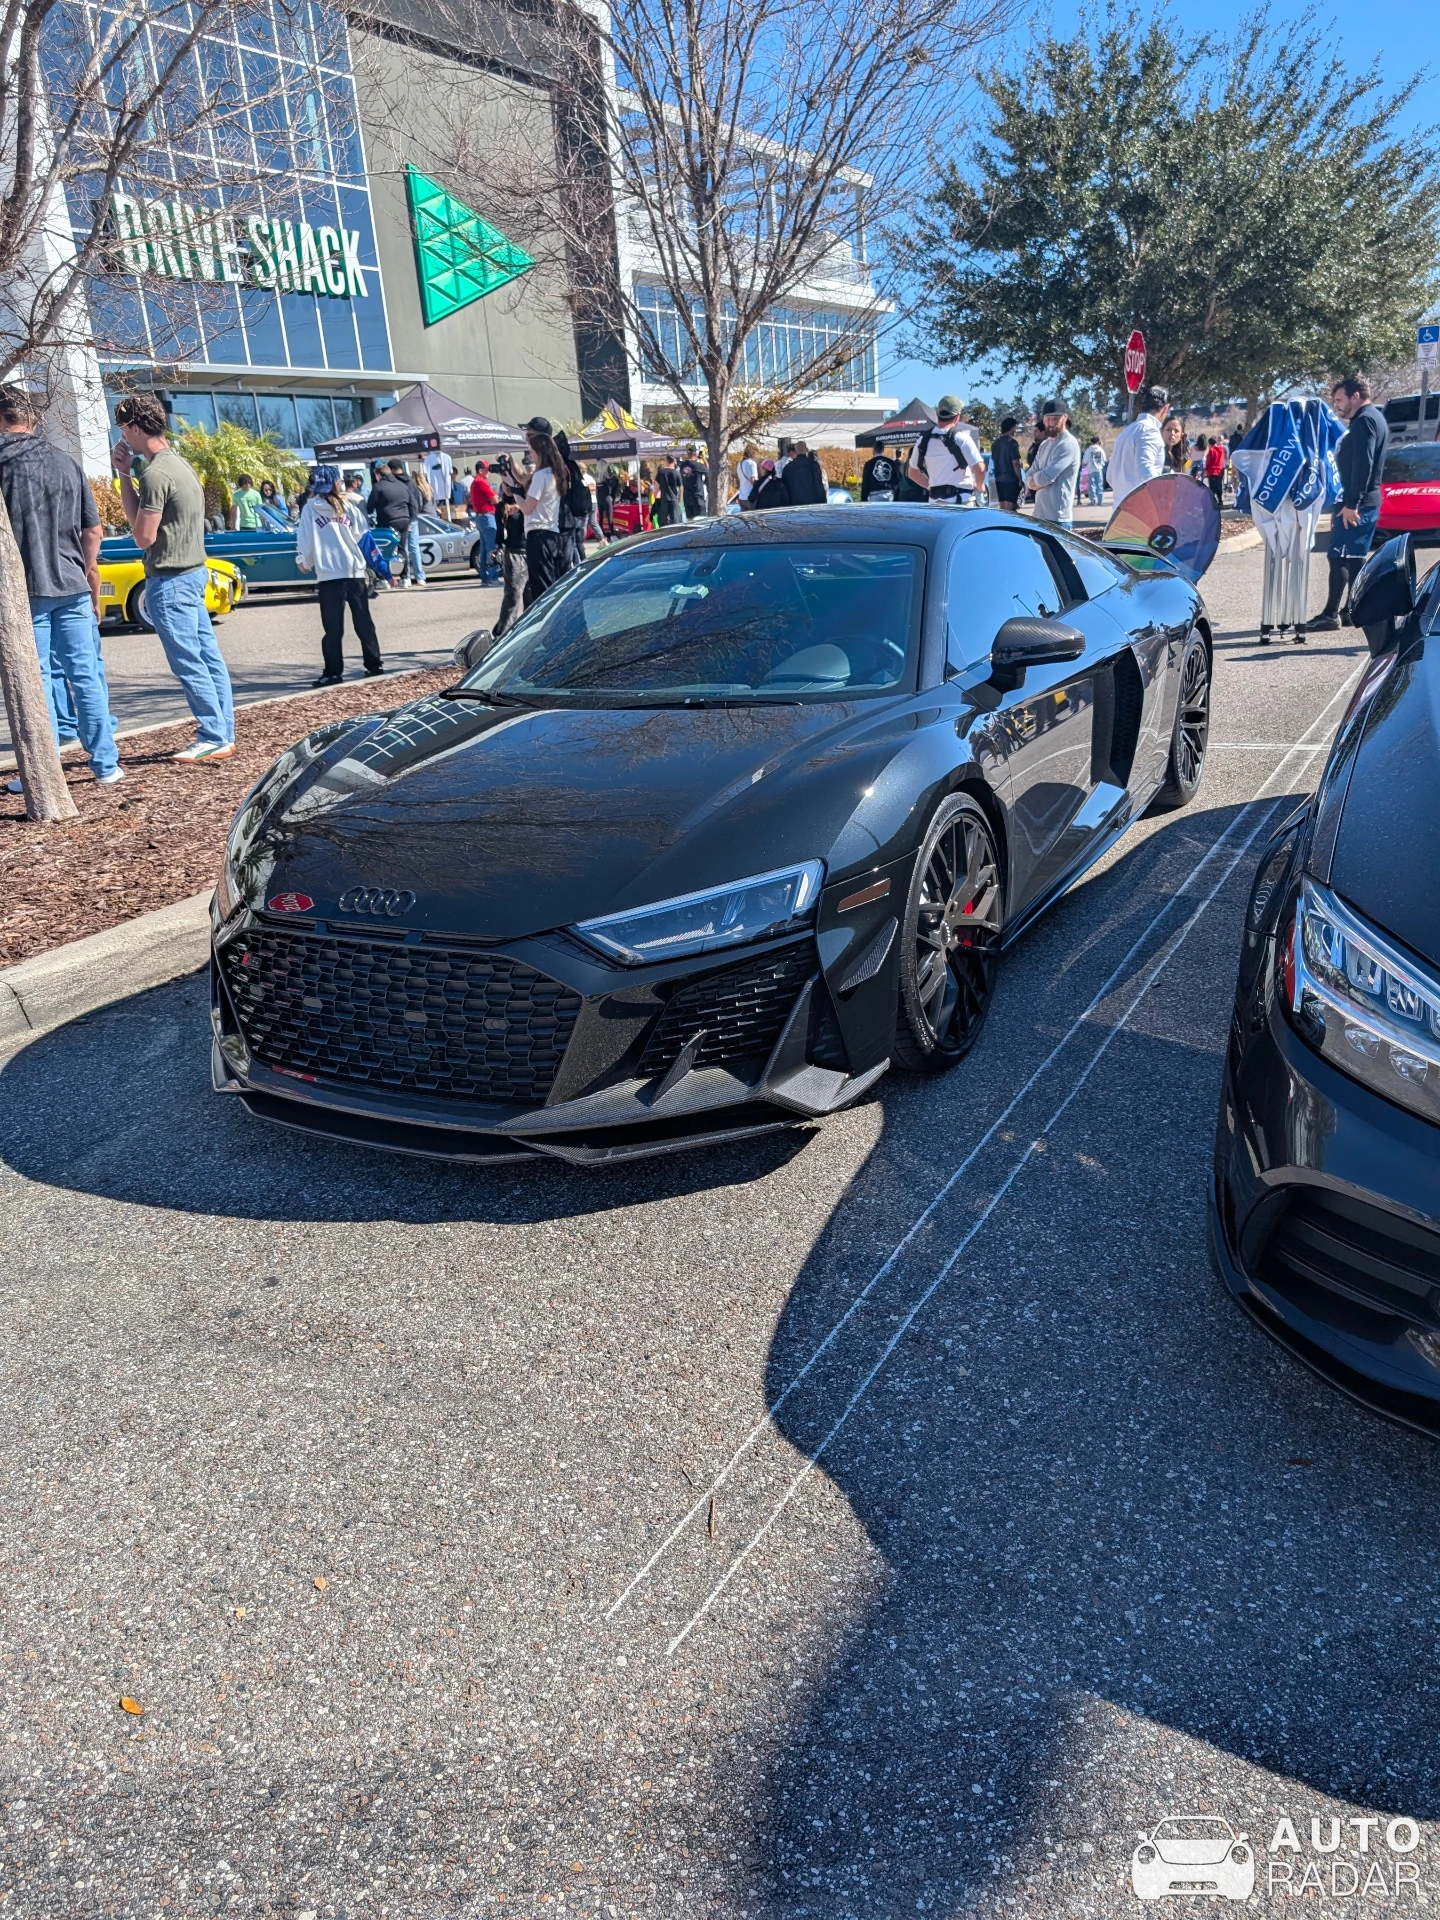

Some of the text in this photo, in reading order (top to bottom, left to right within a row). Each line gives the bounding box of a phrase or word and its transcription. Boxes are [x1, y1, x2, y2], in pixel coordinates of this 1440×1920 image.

[112, 192, 369, 298] DRIVE SHACK
[1125, 349, 1145, 375] STOP
[419, 542, 435, 566] 3
